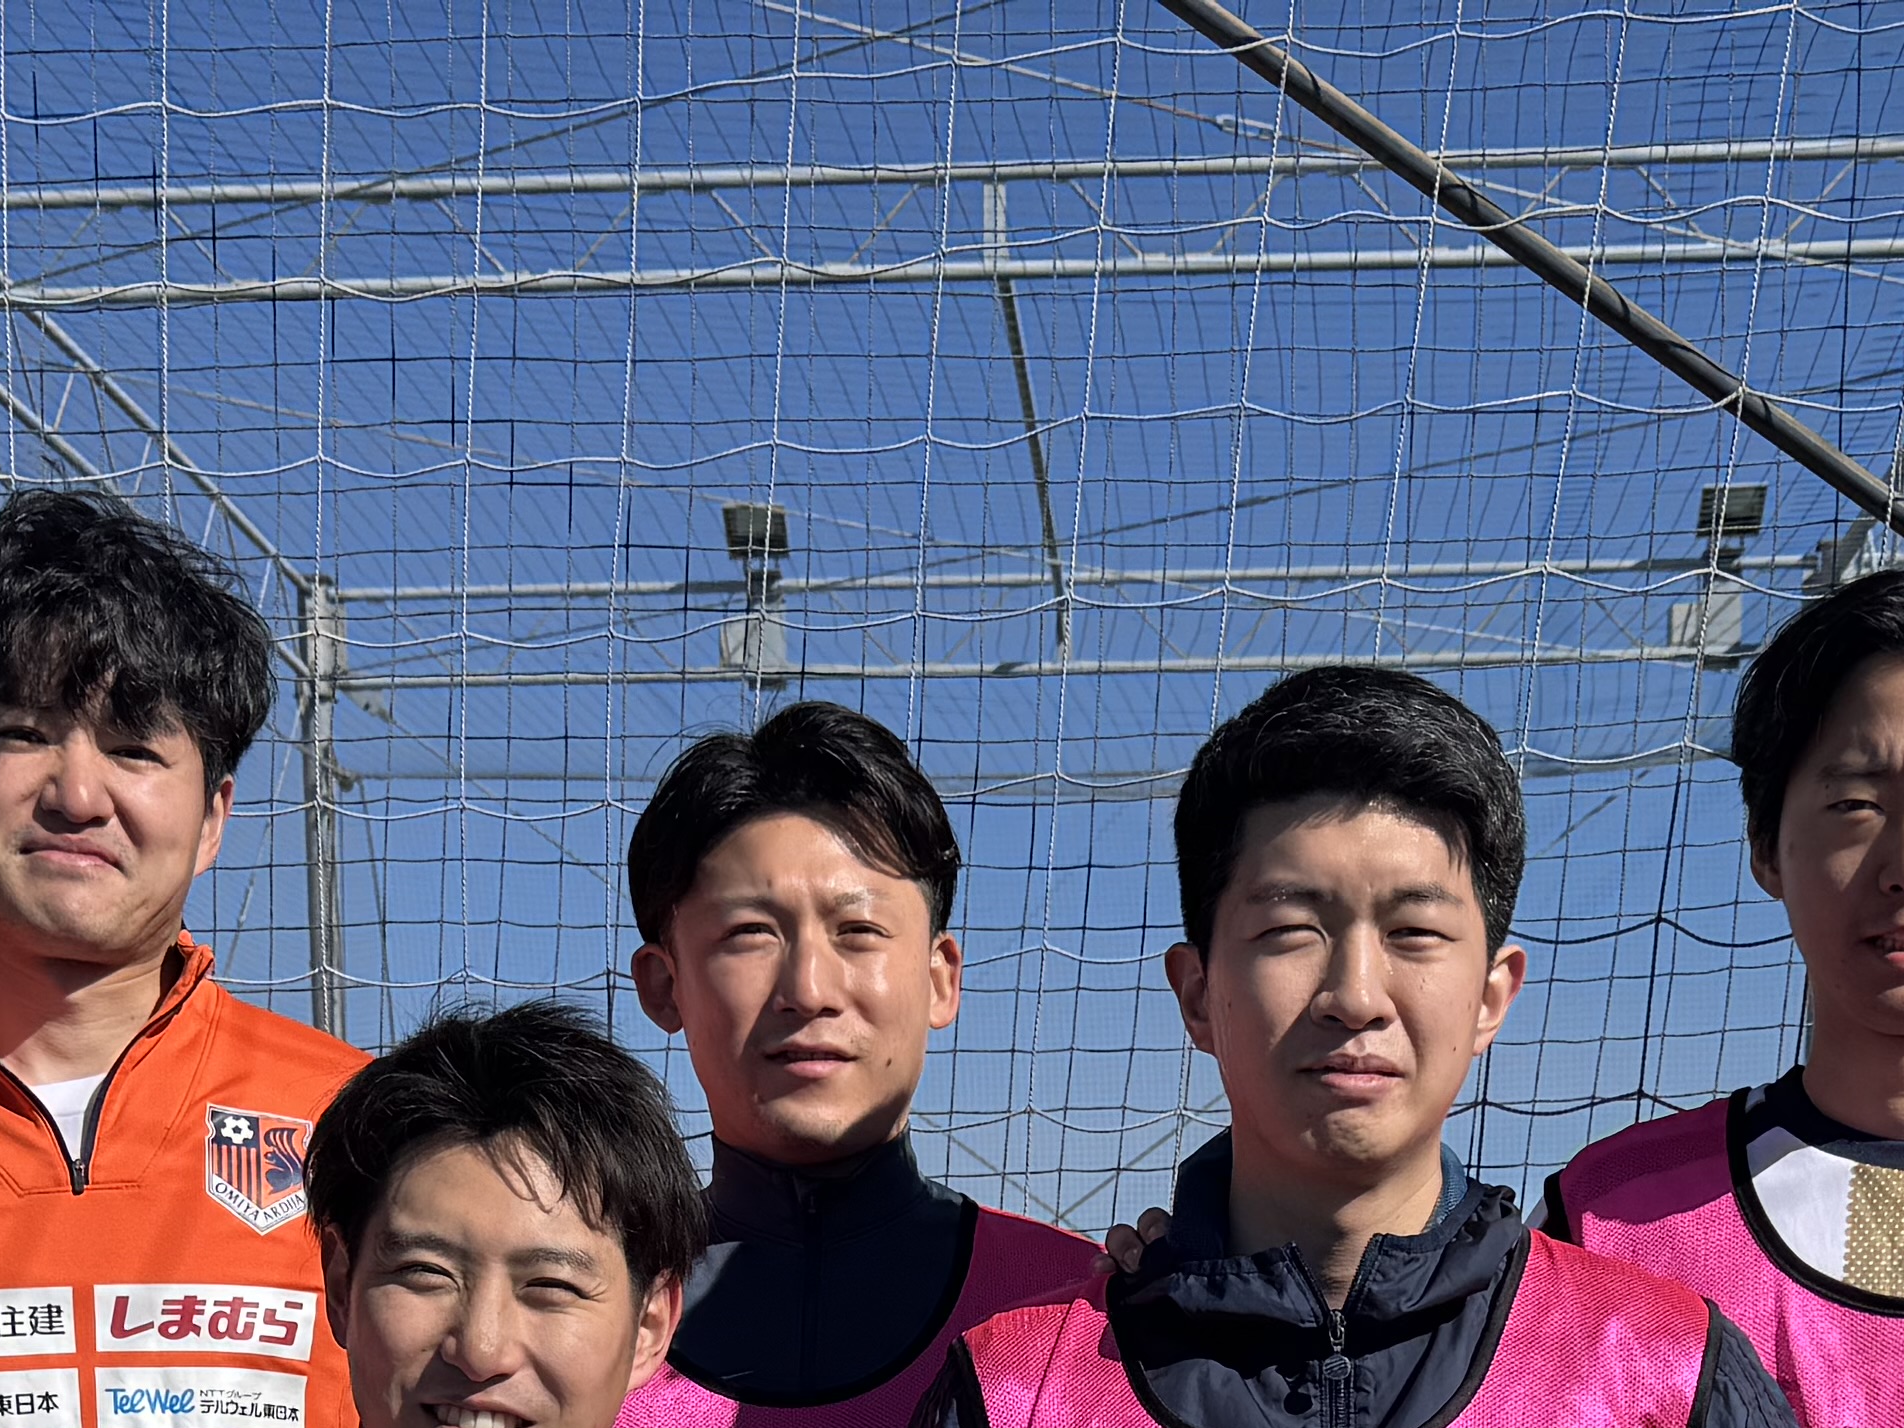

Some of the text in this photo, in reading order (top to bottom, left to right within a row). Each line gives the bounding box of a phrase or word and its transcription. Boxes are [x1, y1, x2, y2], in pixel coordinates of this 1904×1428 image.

[215, 1182, 260, 1222] OMIYA
[110, 1295, 304, 1346] しまむら
[199, 1399, 300, 1422] テルウェル東日本
